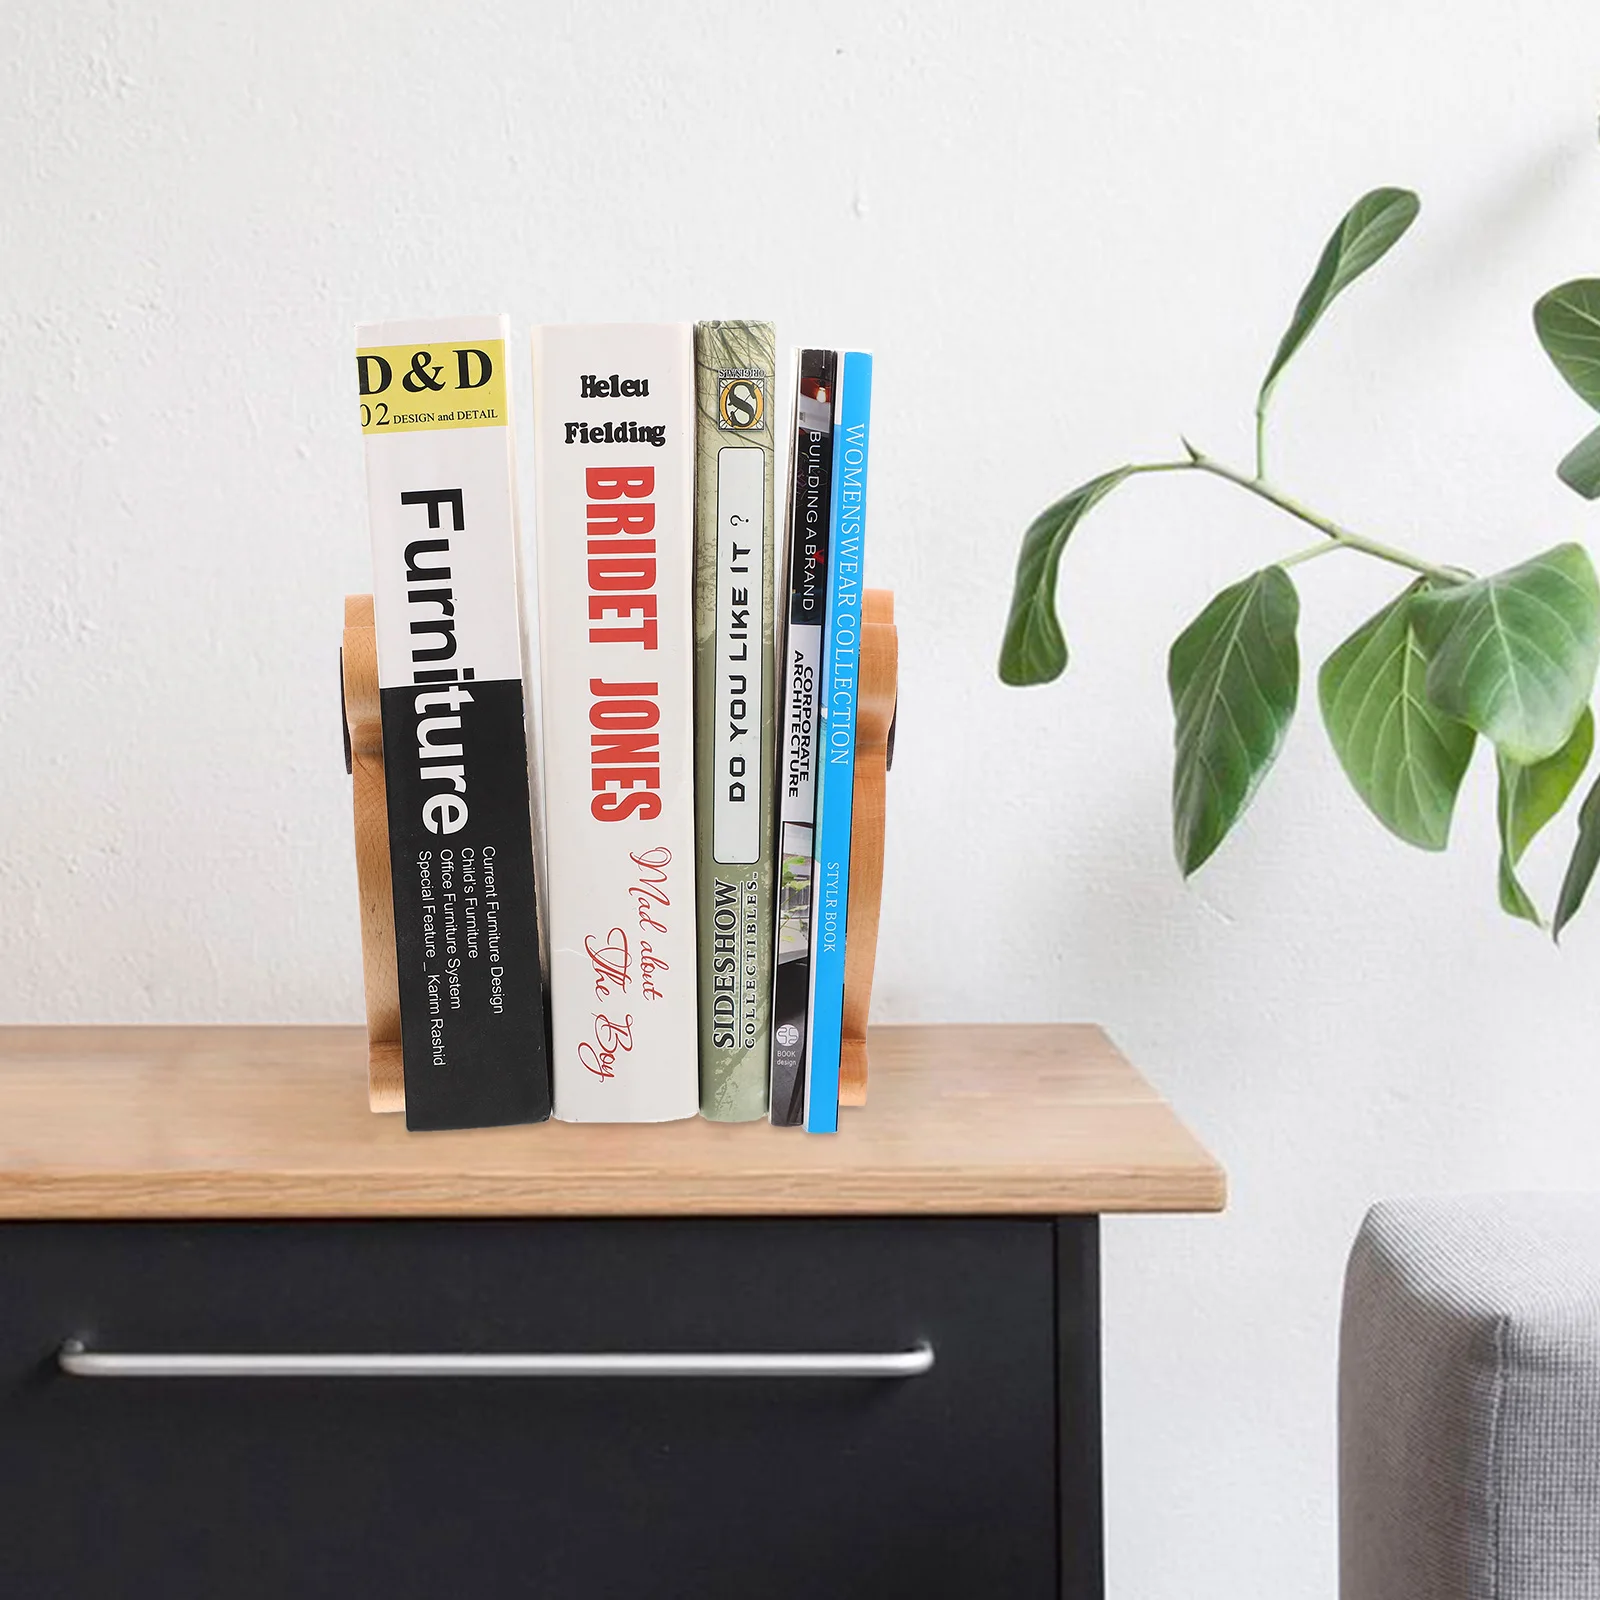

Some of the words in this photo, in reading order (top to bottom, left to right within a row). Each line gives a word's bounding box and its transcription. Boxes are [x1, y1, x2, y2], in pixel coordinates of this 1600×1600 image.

[356, 355, 392, 395] D
[402, 351, 446, 393] &
[453, 349, 493, 389] D
[360, 403, 390, 427] 02
[393, 413, 435, 424] DESIGN
[438, 411, 455, 421] and
[457, 408, 498, 420] DETAIL
[564, 421, 666, 447] Fielding
[806, 431, 822, 523] BUILDING
[730, 514, 749, 526] ?
[806, 526, 818, 541] A
[838, 423, 865, 607] WOMENSWEAR
[585, 466, 659, 650] BRIDET
[730, 541, 751, 573] IT
[803, 544, 817, 611] BRAND
[729, 586, 750, 661] LIKE
[401, 488, 475, 835] Furniture
[729, 674, 749, 742] YOU
[831, 613, 855, 766] COLLECTION
[589, 678, 663, 822] JONES
[789, 650, 804, 798] ARCHITECTURE
[799, 666, 813, 782] CORPORATE
[729, 756, 746, 802] DO
[417, 850, 435, 901] Special
[440, 849, 455, 889] Office
[461, 847, 477, 893] Child's
[482, 846, 498, 898] Current
[628, 846, 672, 933] Mad
[825, 862, 840, 912] STYLR
[422, 905, 436, 958] Feature
[443, 893, 458, 954] Furniture
[465, 897, 480, 959] Furniture
[486, 901, 501, 962] Furniture
[823, 914, 838, 953] BOOK
[445, 958, 461, 1010] System
[489, 966, 505, 1014] Design
[584, 927, 632, 1003] The
[640, 940, 669, 1001] about
[713, 879, 737, 1049] SIDESHOW
[427, 974, 441, 1014] Karim
[431, 1018, 446, 1066] Rashid
[577, 1012, 633, 1083] Boy
[776, 1059, 797, 1068] design
[777, 1050, 796, 1058] BOOK
